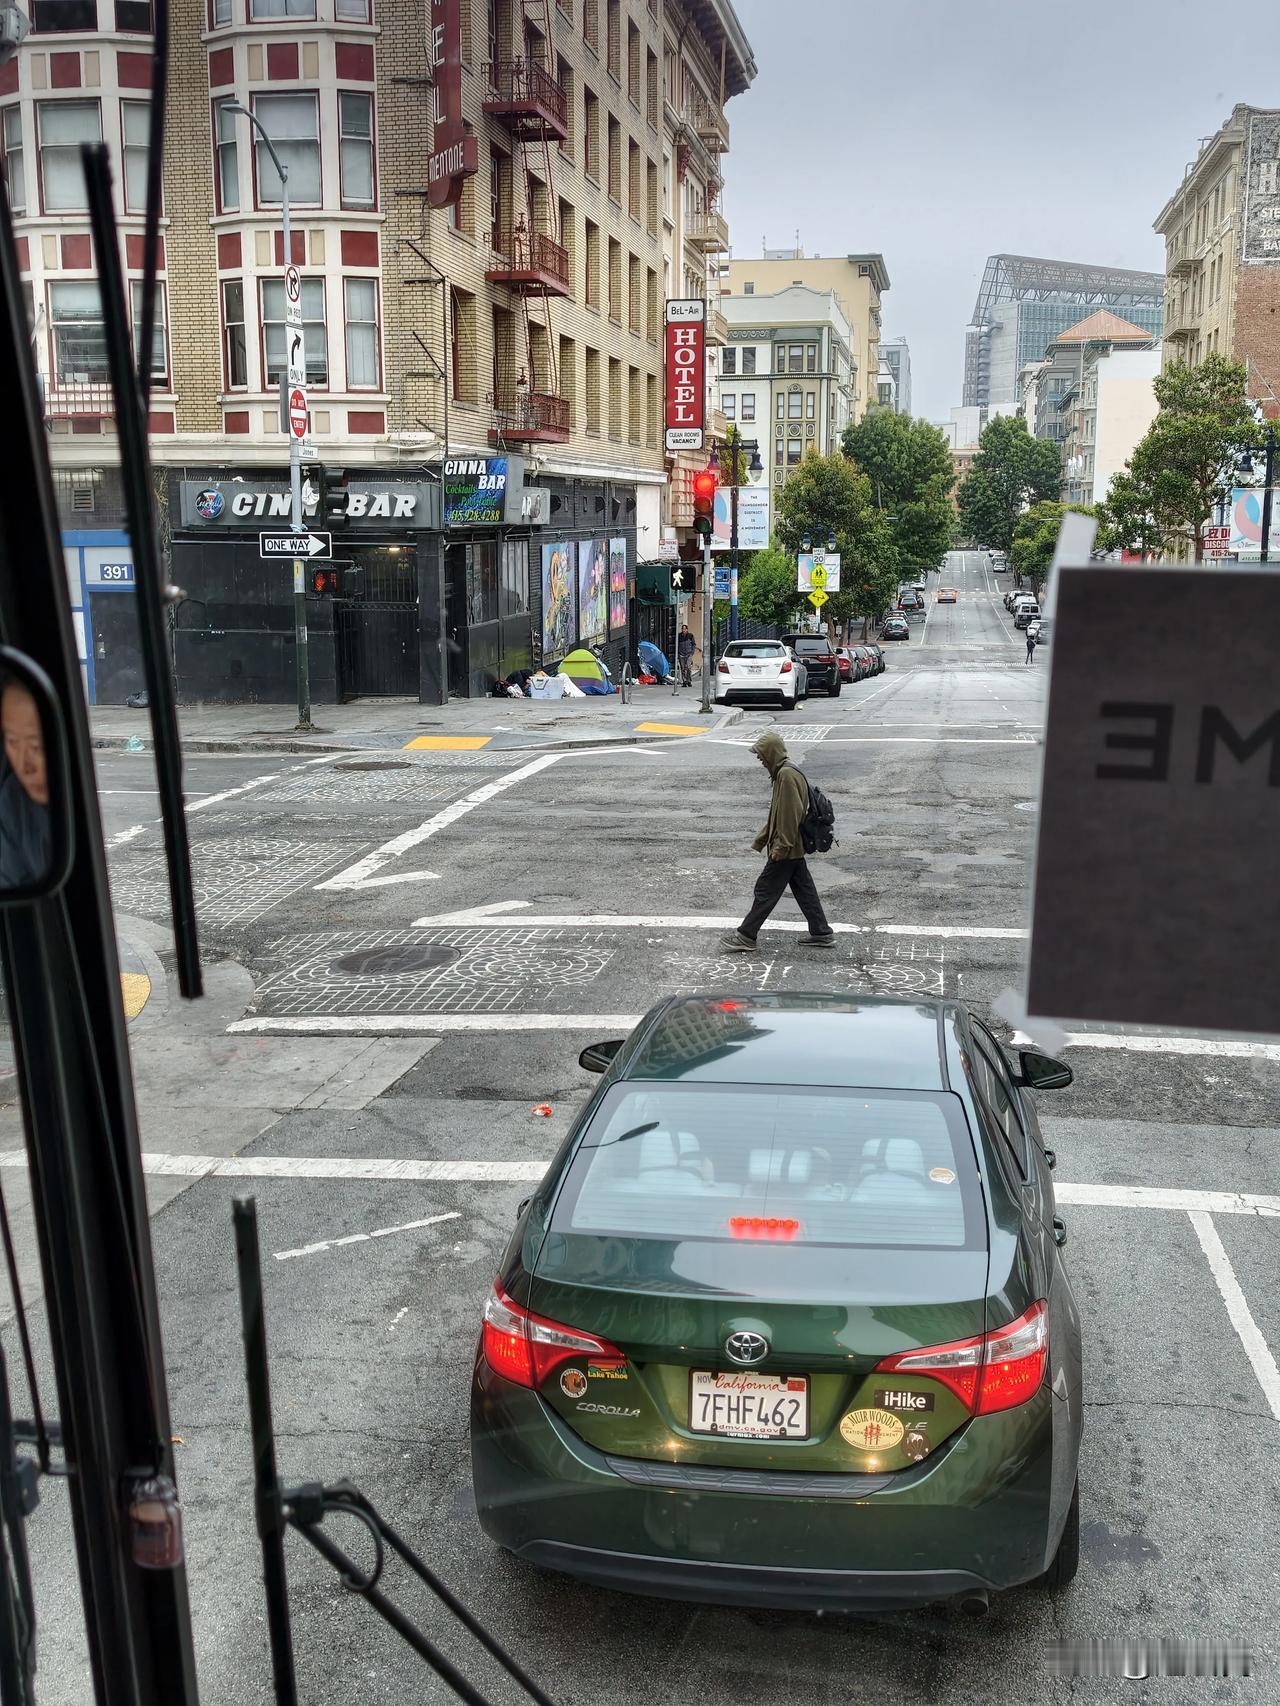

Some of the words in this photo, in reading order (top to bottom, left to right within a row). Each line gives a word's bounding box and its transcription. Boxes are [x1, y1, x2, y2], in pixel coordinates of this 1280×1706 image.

[428, 142, 464, 184] MENTONE
[293, 307, 301, 318] RED
[289, 368, 304, 383] ONLY
[673, 328, 697, 422] HOTEL
[291, 398, 297, 406] DO
[293, 419, 304, 429] ENTER
[302, 446, 314, 457] Jones
[444, 460, 486, 475] CINNA
[478, 474, 506, 490] BAR
[445, 484, 477, 495] Cocktails
[1221, 527, 1230, 539] D
[267, 535, 287, 551] ONE
[290, 534, 310, 551] WAY
[814, 555, 824, 563] 20
[103, 565, 128, 579] 391
[588, 1371, 605, 1379] Lake
[605, 1372, 628, 1380] Tahoe
[697, 1375, 711, 1384] NOV
[715, 1374, 787, 1394] California
[884, 1391, 926, 1408] iHike
[576, 1402, 641, 1417] COROLLA
[698, 1393, 800, 1428] 7FHF462
[847, 1411, 868, 1427] MUIR
[869, 1410, 898, 1429] WOODS
[905, 1421, 928, 1431] LE
[719, 1424, 780, 1433] dmv.ca.gov
